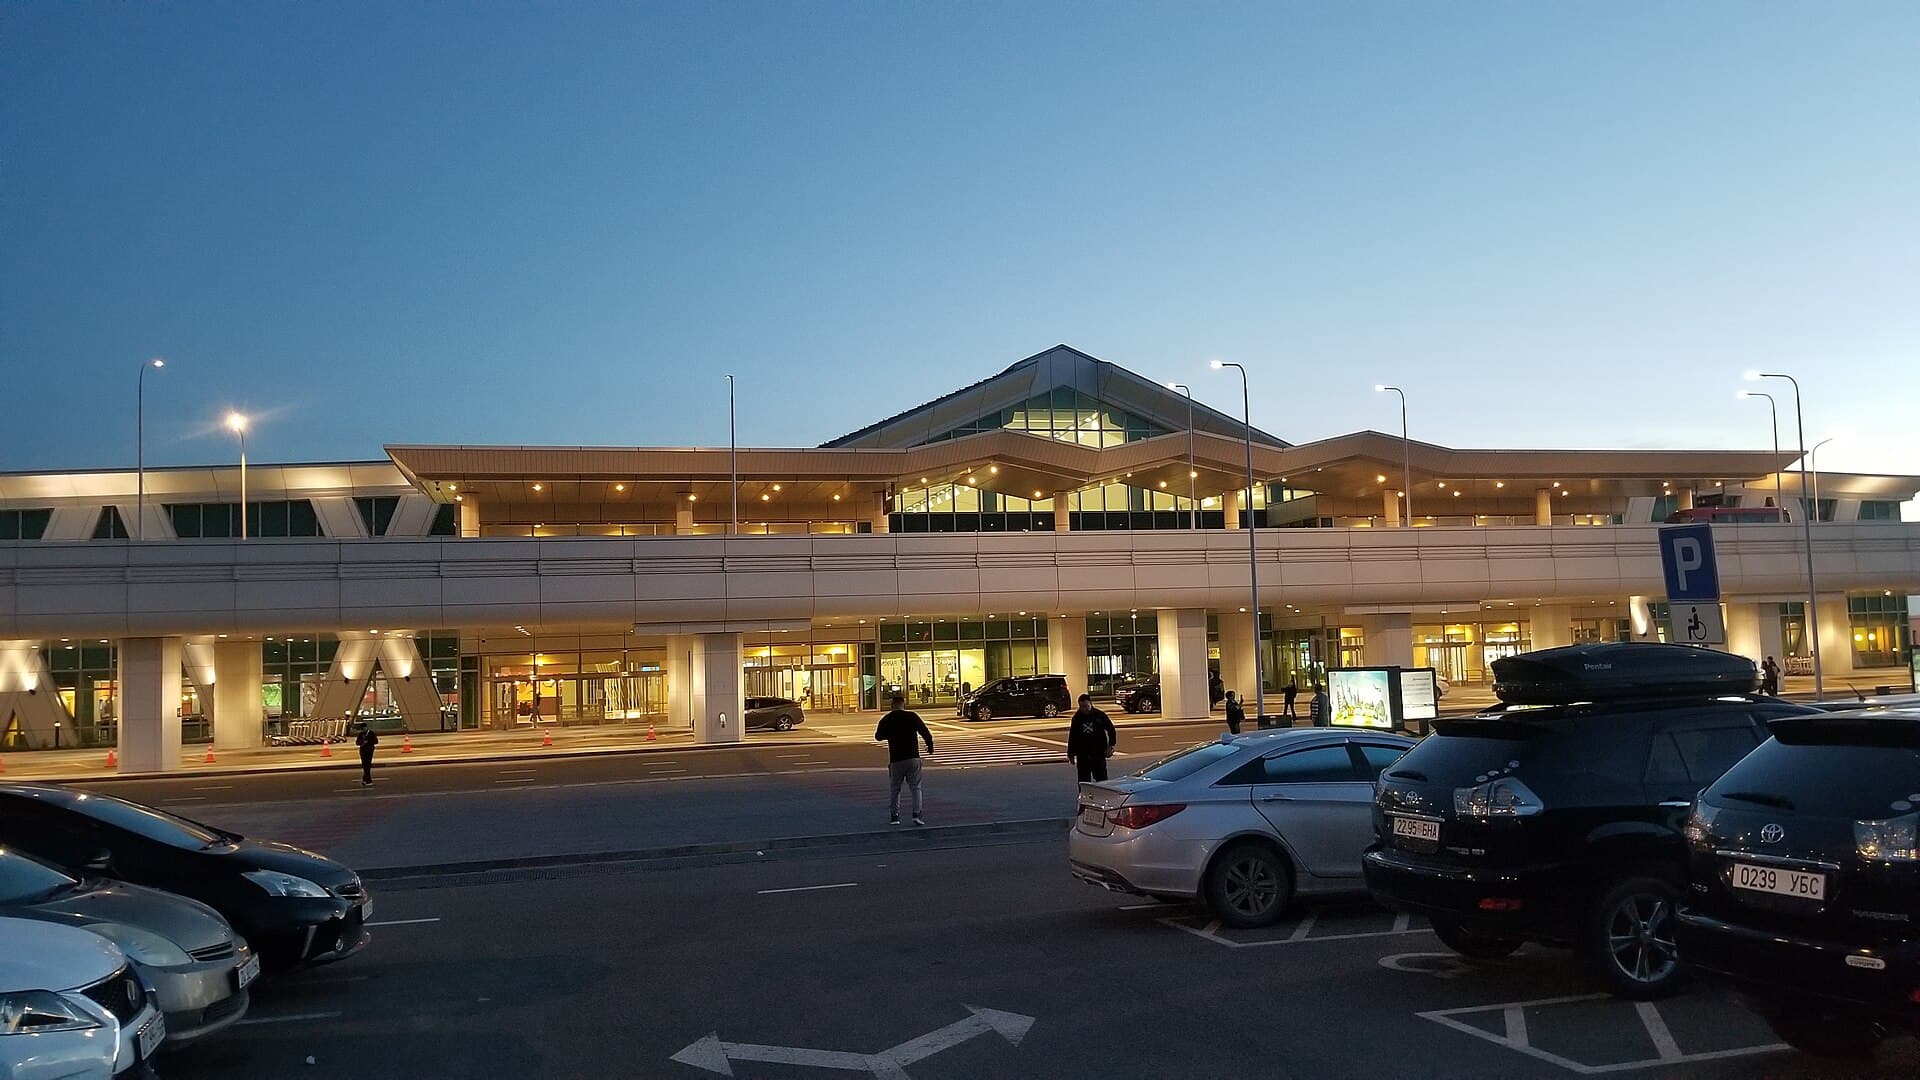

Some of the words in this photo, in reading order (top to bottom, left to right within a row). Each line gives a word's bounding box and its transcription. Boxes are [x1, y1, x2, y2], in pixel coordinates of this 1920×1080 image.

[1673, 538, 1702, 591] P
[1740, 867, 1777, 890] 0239
[1790, 873, 1819, 895] УБС
